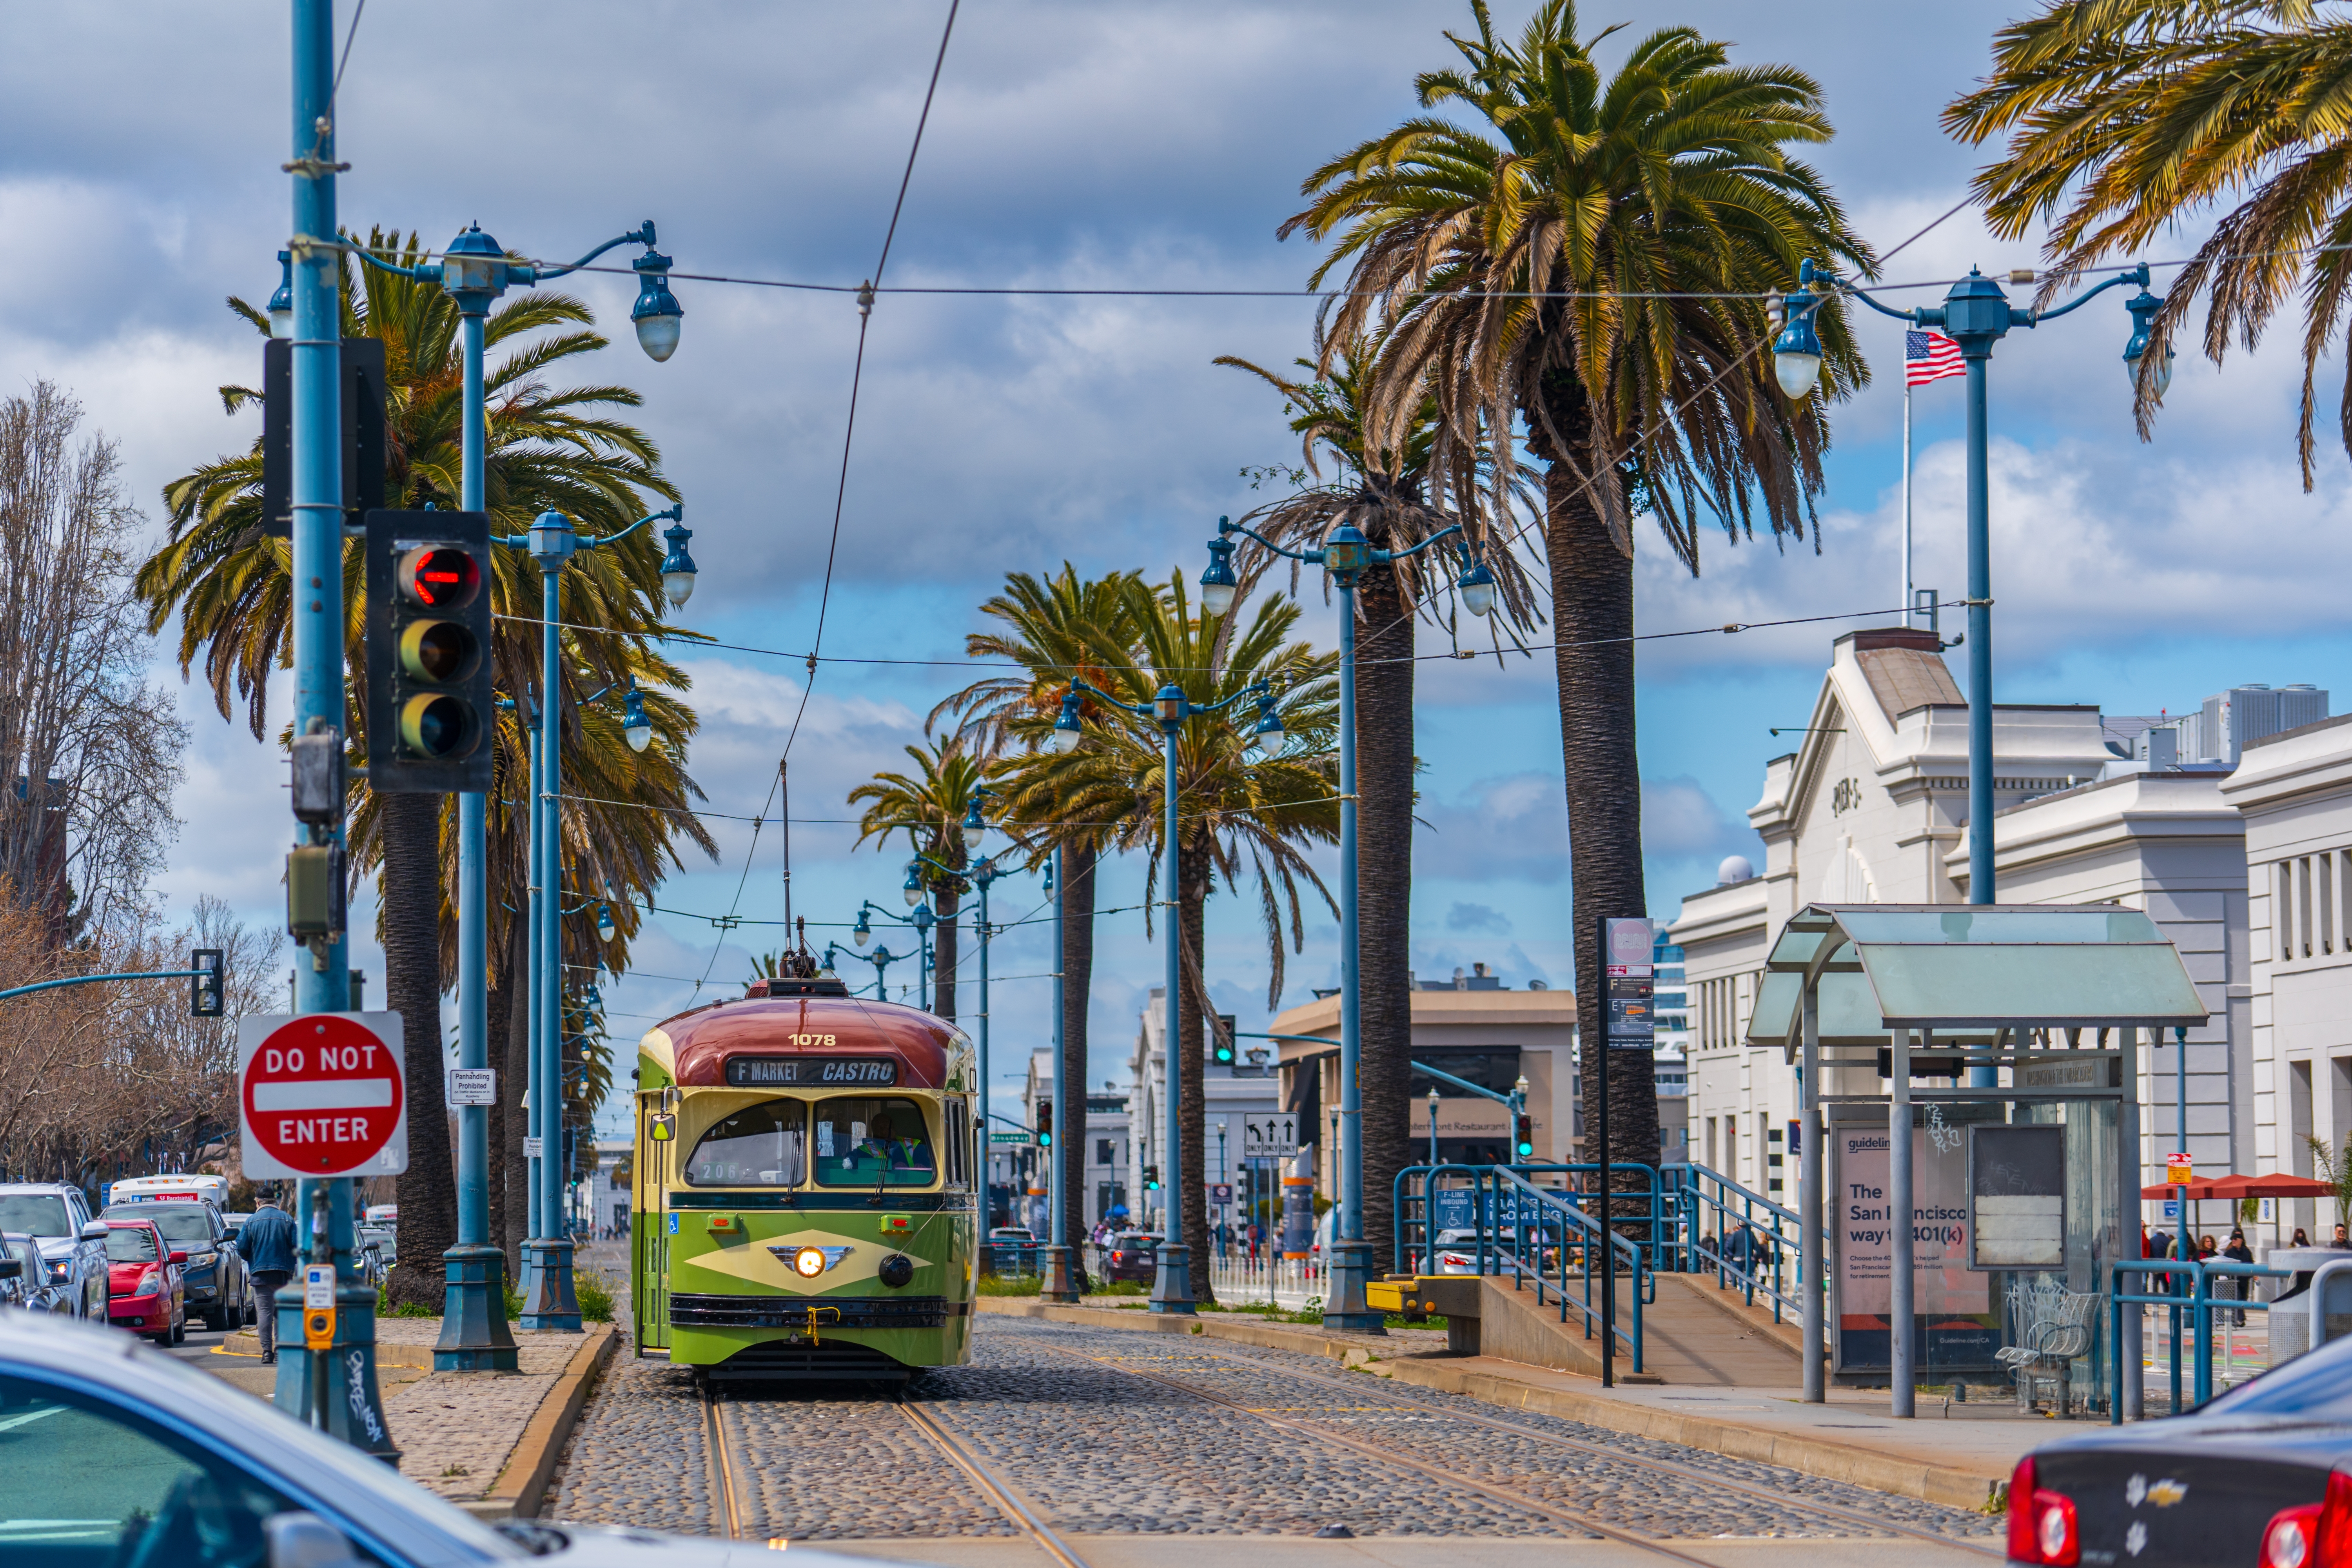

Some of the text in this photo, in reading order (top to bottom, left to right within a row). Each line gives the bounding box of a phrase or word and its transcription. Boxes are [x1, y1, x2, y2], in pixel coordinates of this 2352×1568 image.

[1610, 979, 1618, 990] F
[1612, 1001, 1618, 1011] E
[788, 1034, 836, 1046] 1078
[266, 1045, 377, 1073] DO NOT
[739, 1062, 893, 1080] F MARKET CASTRO
[2026, 1070, 2053, 1087] WASHINGTON
[2053, 1069, 2056, 1085] &
[2064, 1065, 2093, 1084] EMBARCADERO
[279, 1117, 369, 1144] ENTER
[1410, 1118, 1454, 1131] aterfont
[1454, 1121, 1505, 1131] Restaurant
[1849, 1137, 1890, 1151] guidelin
[1849, 1184, 1882, 1199] The
[1533, 1210, 1569, 1220] EG
[1850, 1205, 1966, 1221] San ncisco
[1850, 1231, 1884, 1245] way
